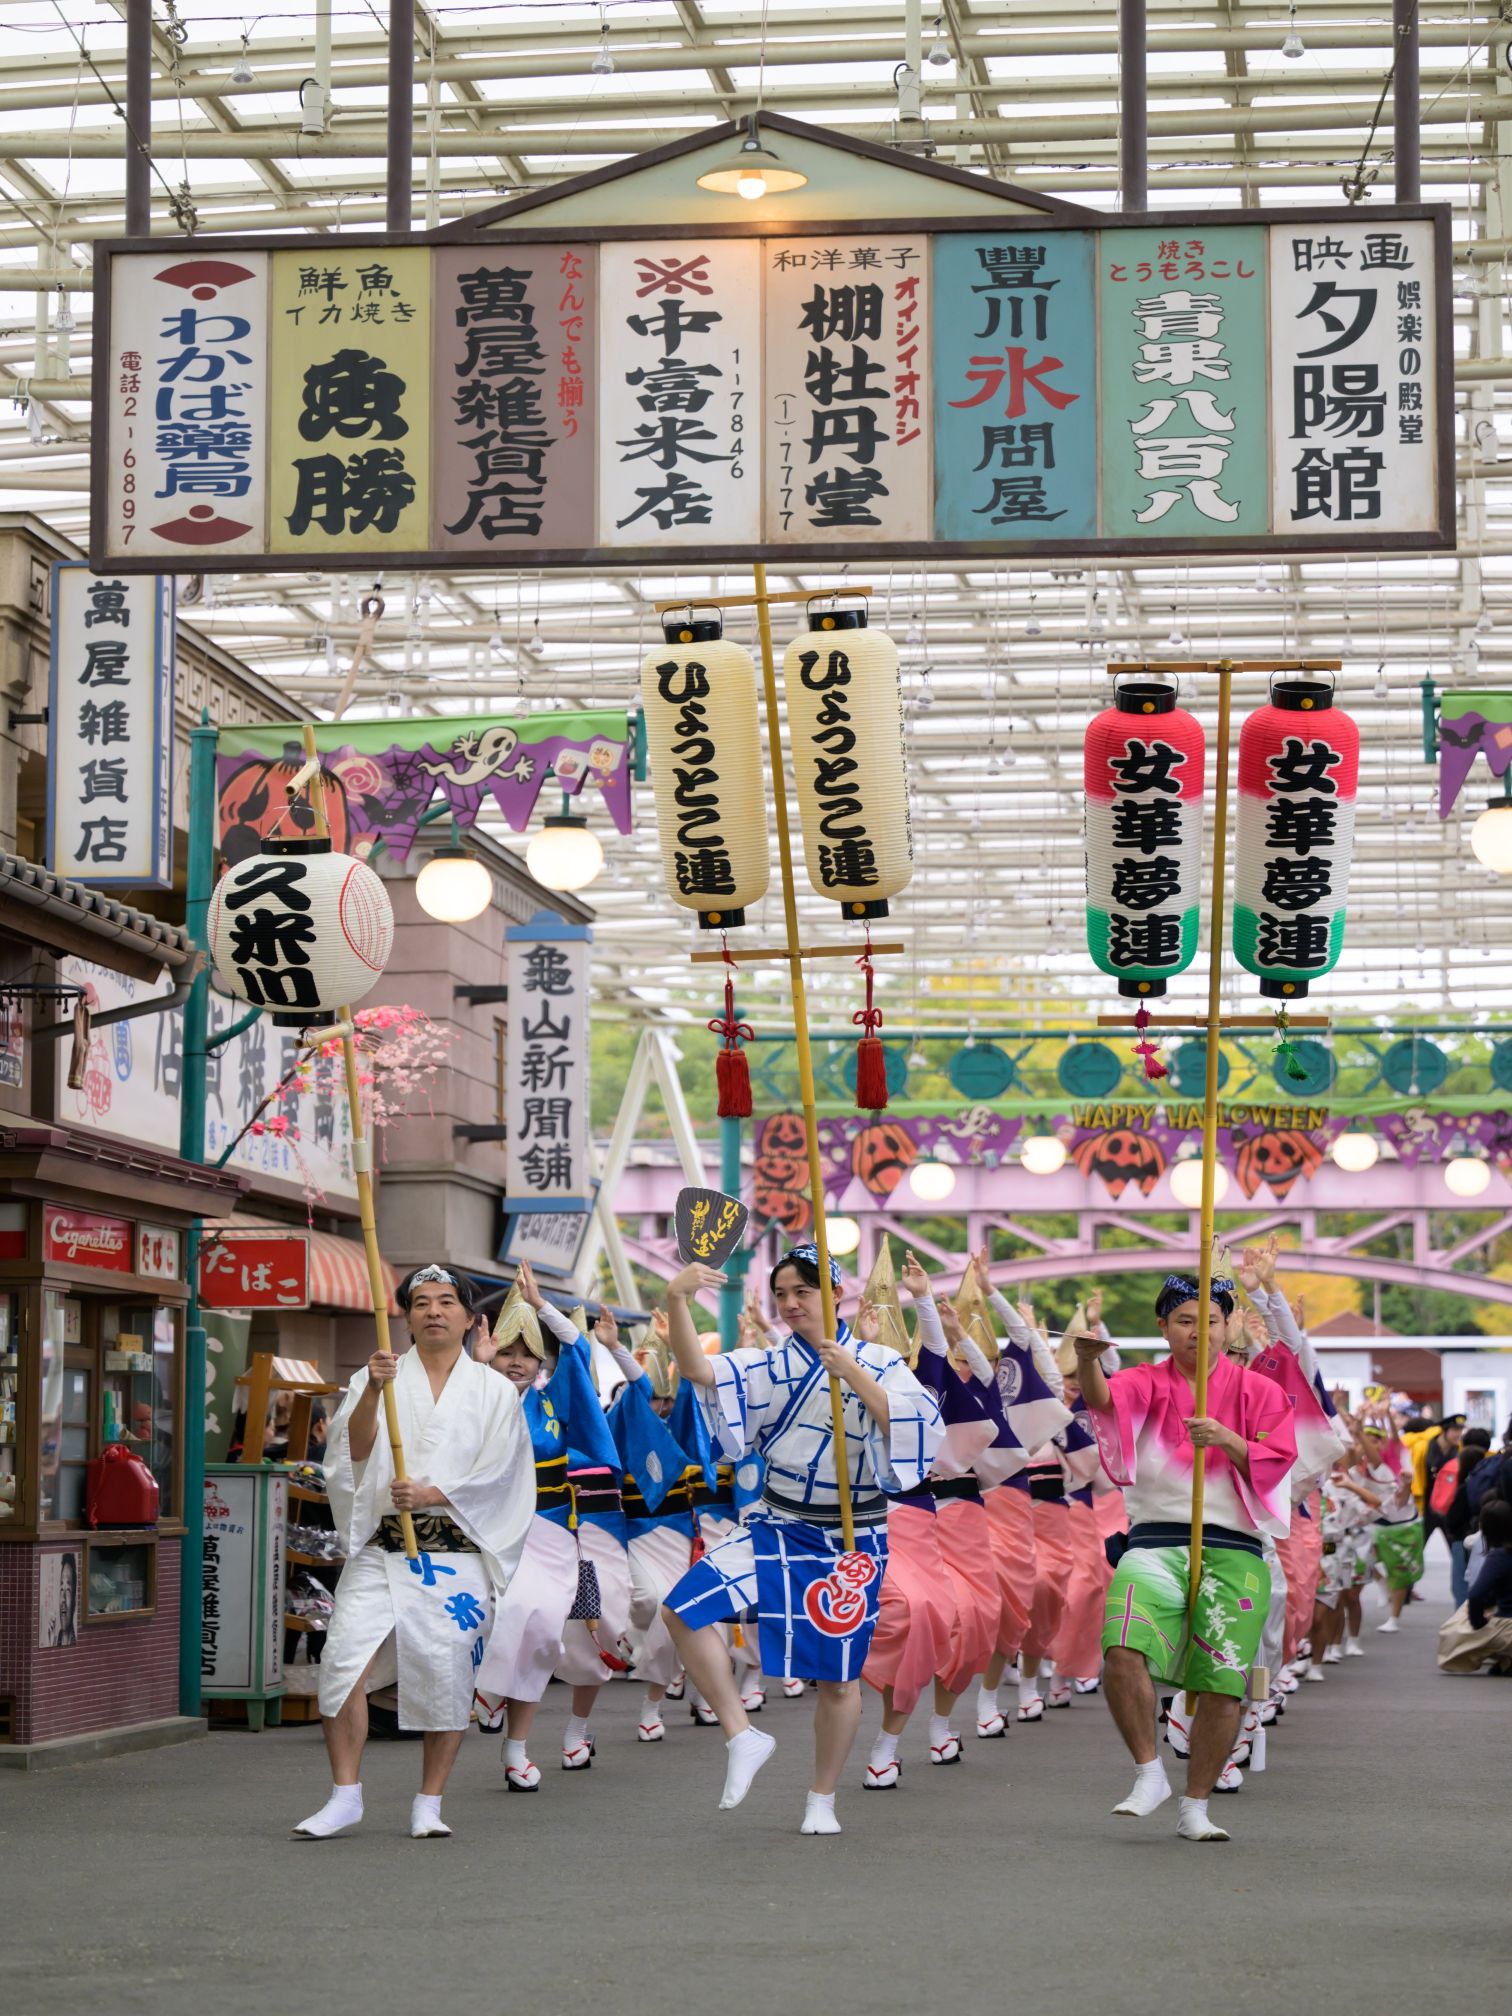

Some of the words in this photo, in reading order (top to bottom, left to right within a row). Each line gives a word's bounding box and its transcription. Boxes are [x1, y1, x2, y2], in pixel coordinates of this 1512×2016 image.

[285, 302, 417, 325] イカ焼き
[298, 264, 400, 301] 鮮魚
[772, 247, 921, 272] 和洋菓子
[1110, 261, 1256, 282] とうもろこし
[1157, 240, 1205, 259] 焼き
[1292, 233, 1415, 272] 映画
[557, 251, 584, 439] なんでも揃う
[615, 299, 738, 530] 中富米店
[797, 282, 891, 528] 棚牡丹堂
[894, 276, 921, 447] オイシイオカシ
[1127, 289, 1241, 524] 青果八百八
[1288, 280, 1387, 523] 夕陽館
[1397, 280, 1424, 445] 娯楽の殿堂
[74, 580, 131, 863] 萬屋雑貨店
[655, 660, 736, 896] ひょっとこ連
[798, 650, 880, 888] ひょっとこ連
[225, 861, 321, 1007] 久米川
[1107, 738, 1188, 969] 女華夢連
[1254, 736, 1342, 969] 女華夢連
[1071, 1103, 1156, 1130] HAPPY
[1166, 1103, 1328, 1130] HALOWEEN
[50, 1215, 123, 1258] Cigarettes
[206, 1244, 300, 1304] たばこ
